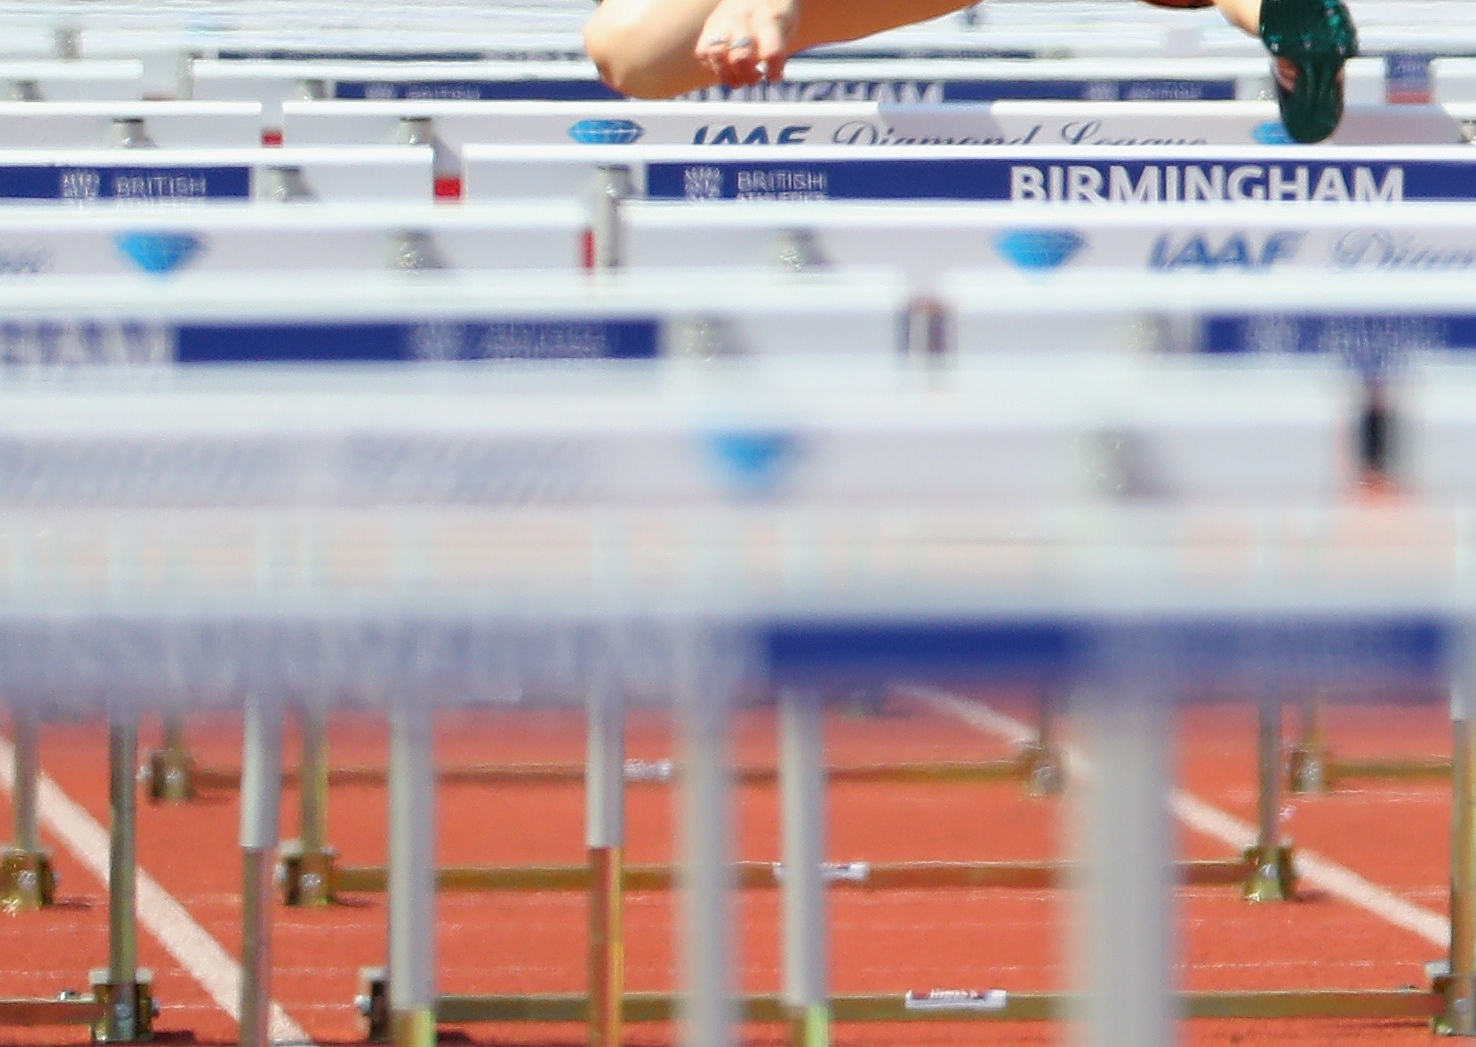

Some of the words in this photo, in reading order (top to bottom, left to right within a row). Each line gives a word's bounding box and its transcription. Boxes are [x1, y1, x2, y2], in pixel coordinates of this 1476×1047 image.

[115, 176, 207, 197] BRITISH
[737, 170, 826, 191] BRITISH
[1010, 165, 1402, 203] BIRMINGHAM
[1147, 231, 1307, 274] IAAF
